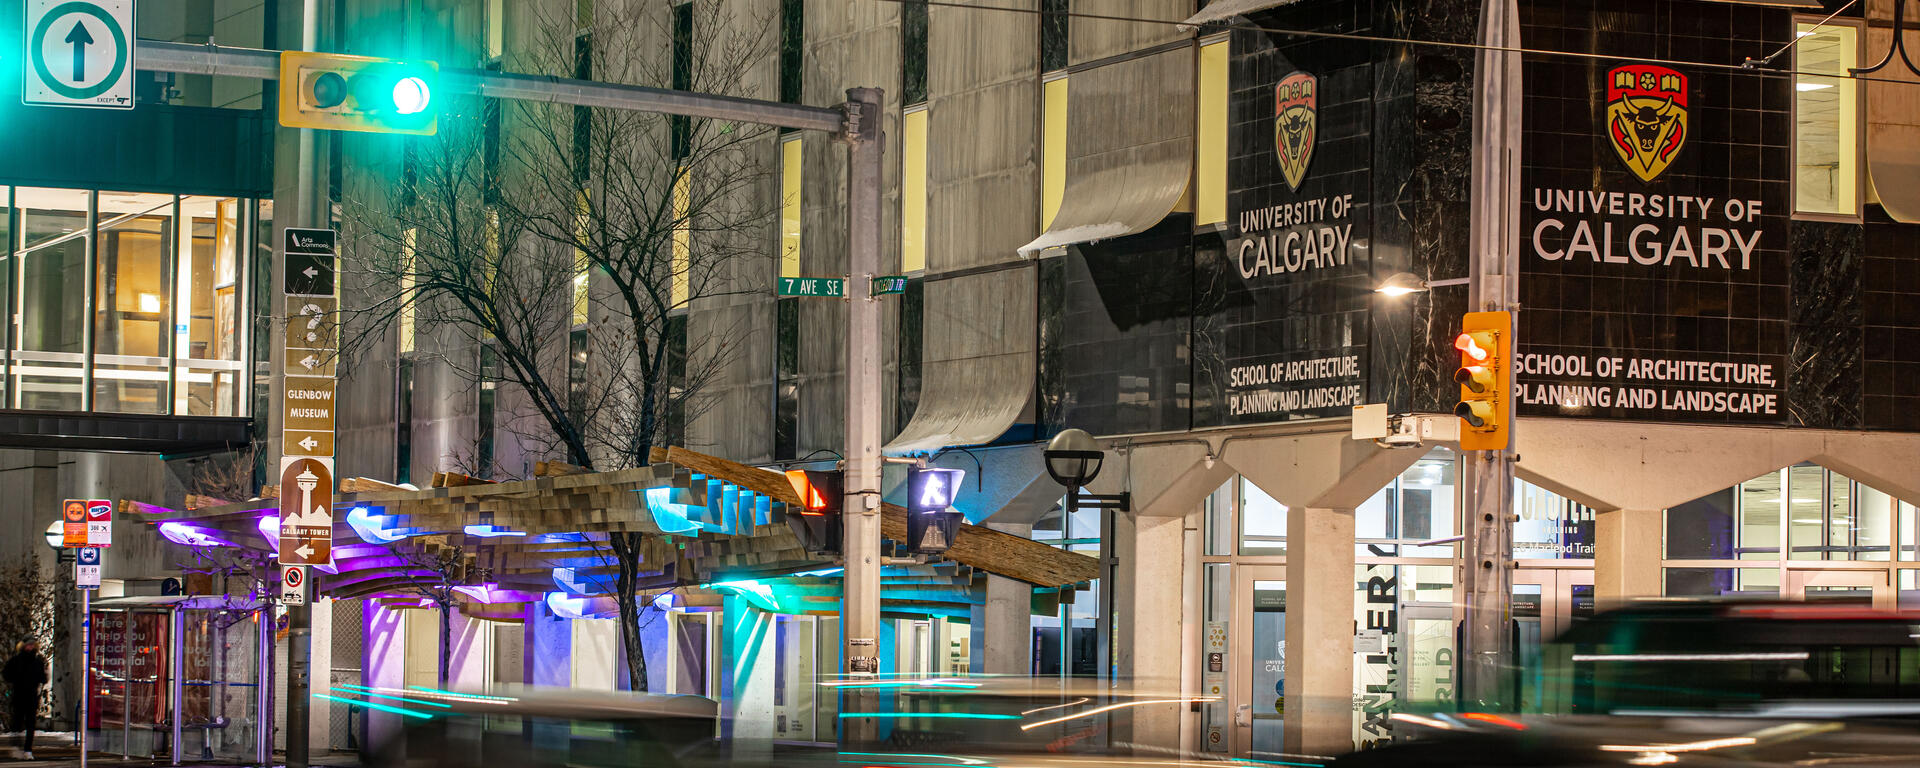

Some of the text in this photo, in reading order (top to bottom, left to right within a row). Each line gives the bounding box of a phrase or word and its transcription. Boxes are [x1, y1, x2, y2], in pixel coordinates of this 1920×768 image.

[1240, 194, 1352, 233] UNIVERSITY OF
[1535, 188, 1763, 222] UNIVERSITY OF
[1239, 224, 1352, 279] CALGARY
[1533, 218, 1763, 270] CALGARY
[785, 279, 839, 295] 7 AVE SE
[896, 278, 904, 291] TR
[1230, 355, 1360, 387] SCHOOL OF ARCHITECTURE,
[1515, 353, 1777, 388] SCHOOL OF ARCHITECTURE,
[287, 390, 332, 400] GLENBOW
[1230, 385, 1360, 416] PLANNING AND LANDSCAPE
[1515, 384, 1777, 415] PLANNING AND LANDSCAPE
[290, 407, 329, 418] MUSEUM
[310, 528, 329, 536] TOWER
[96, 618, 122, 628] Here
[96, 631, 121, 643] help
[96, 655, 146, 666] finanial
[1435, 647, 1453, 704] RLD
[1362, 695, 1380, 736] AN
